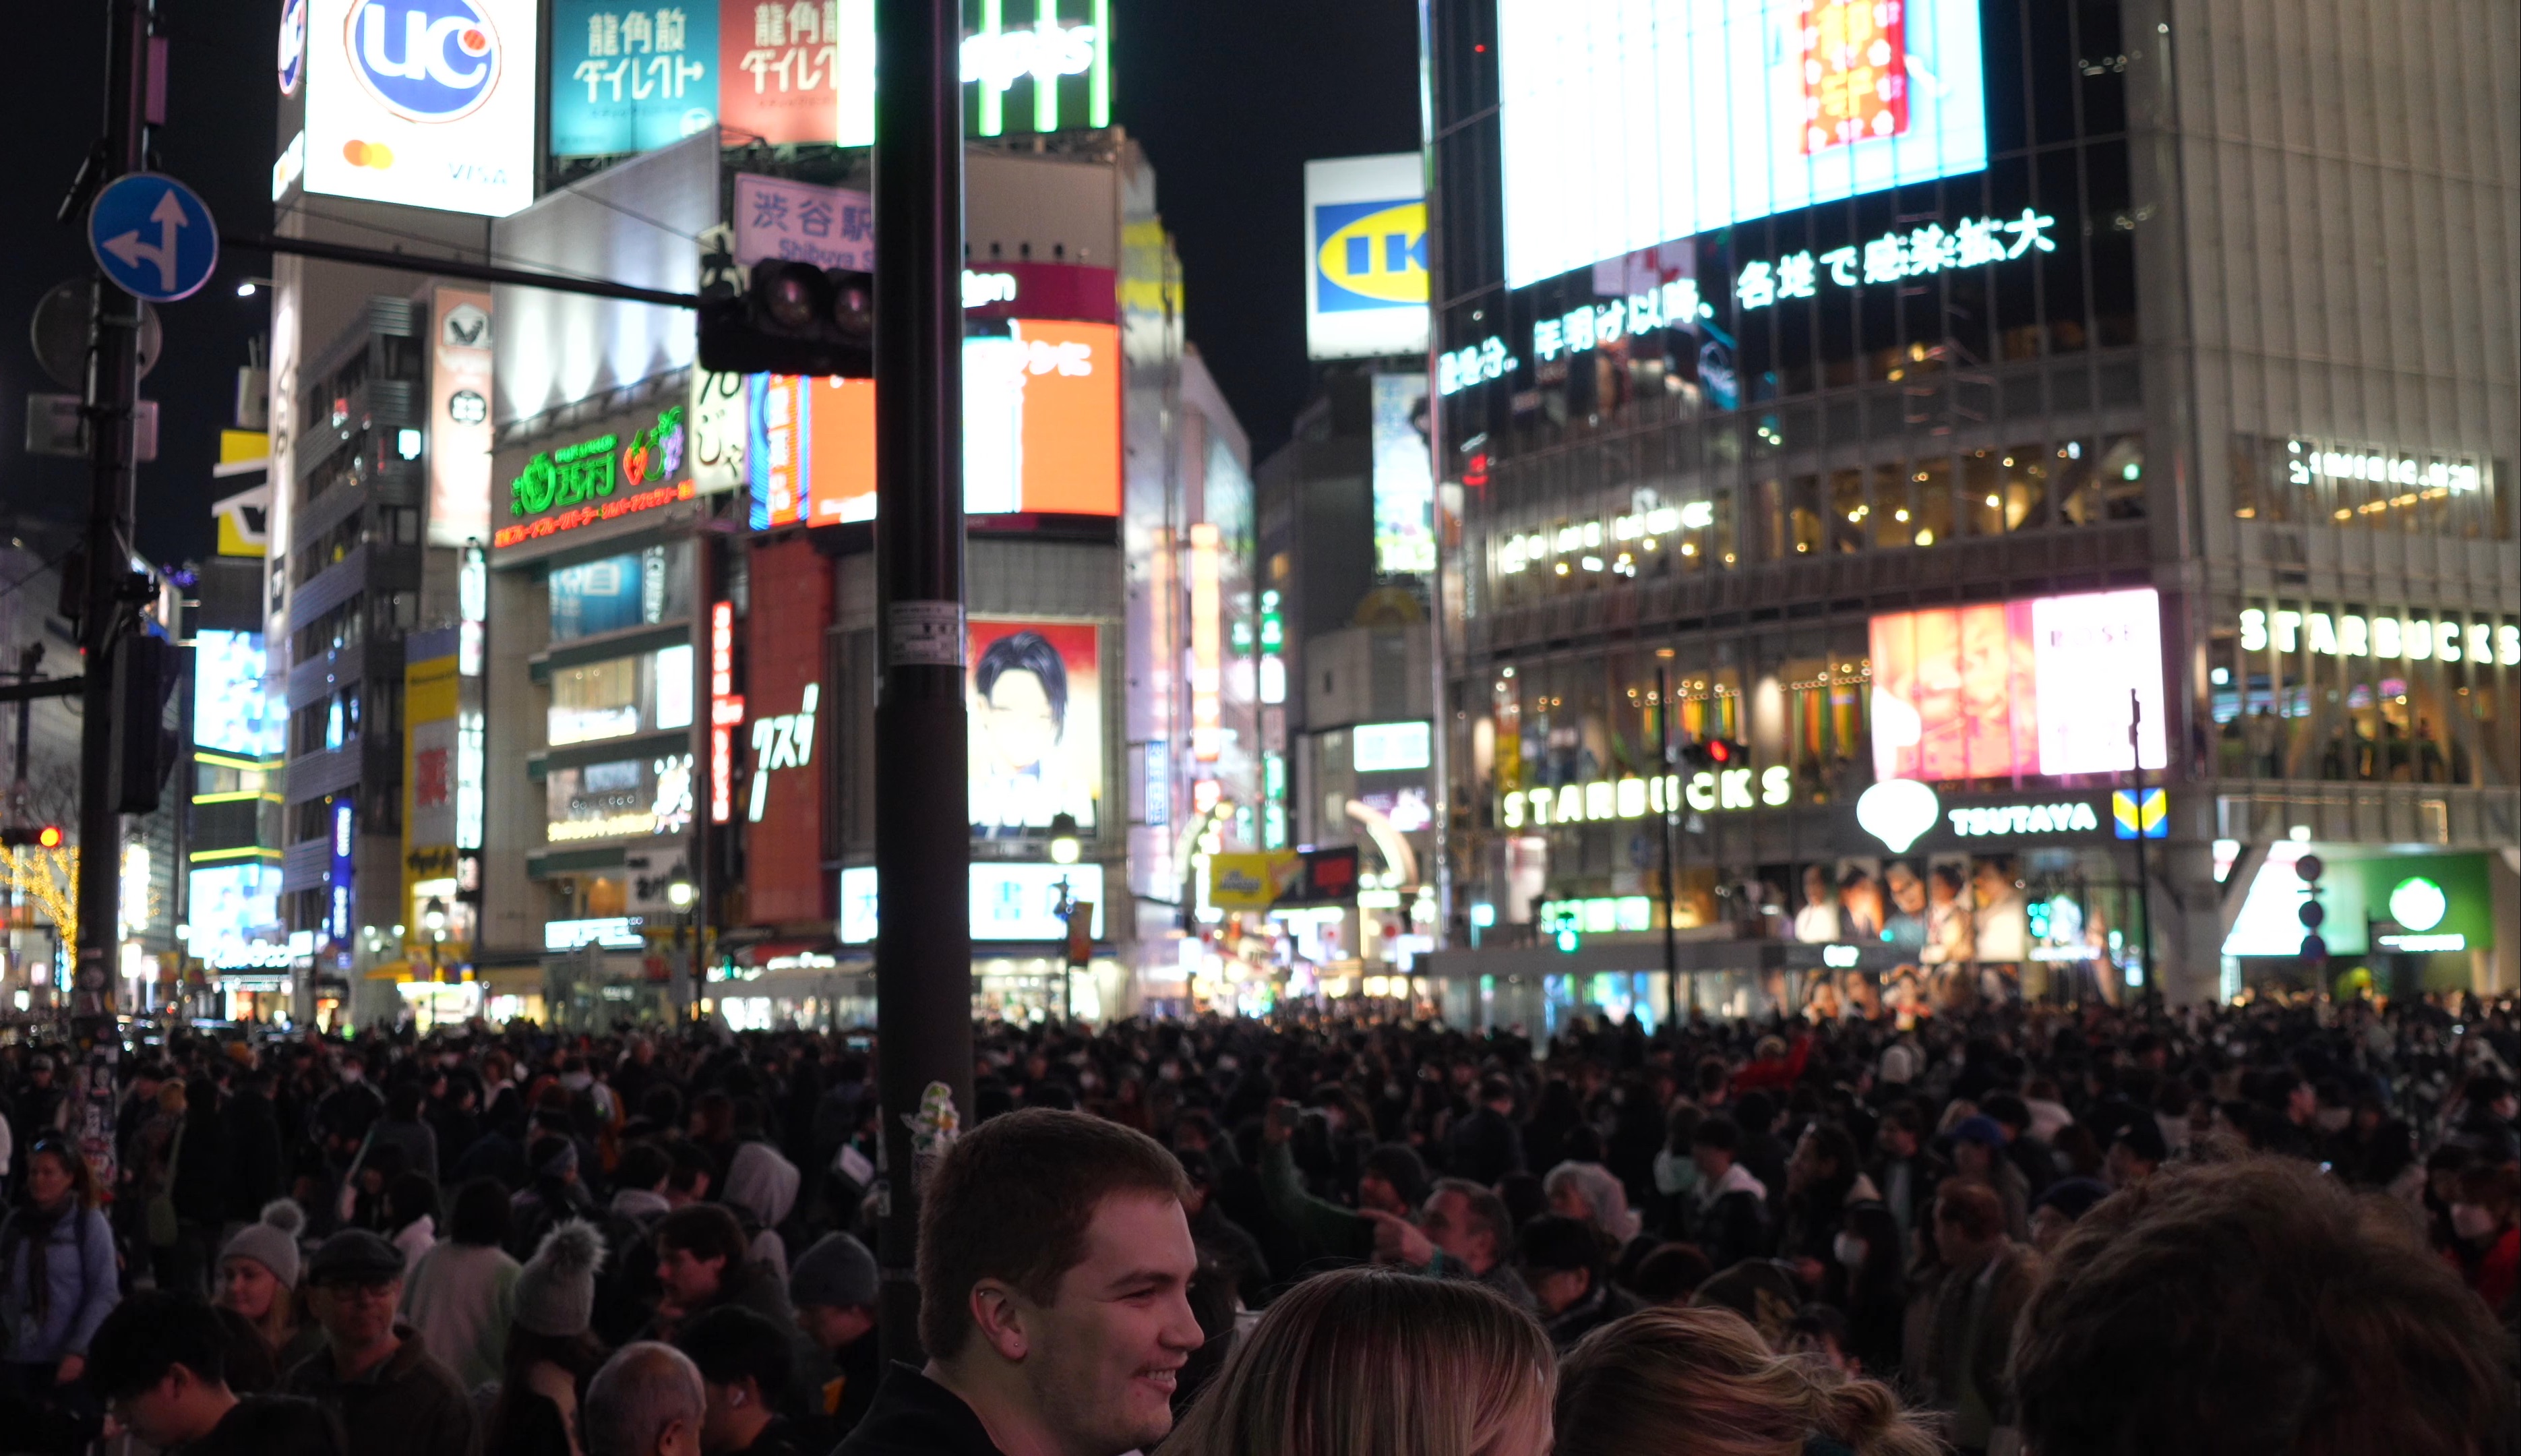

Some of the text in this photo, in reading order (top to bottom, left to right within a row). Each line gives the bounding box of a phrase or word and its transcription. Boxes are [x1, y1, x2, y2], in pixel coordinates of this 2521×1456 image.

[588, 7, 687, 57] 龍角散
[574, 55, 704, 103] ダイレクト
[448, 162, 508, 185] VISA
[2240, 608, 2520, 666] STARBUCKS
[1504, 766, 1790, 828] STARBUCKS
[1948, 802, 2097, 836] TSUTAYA
